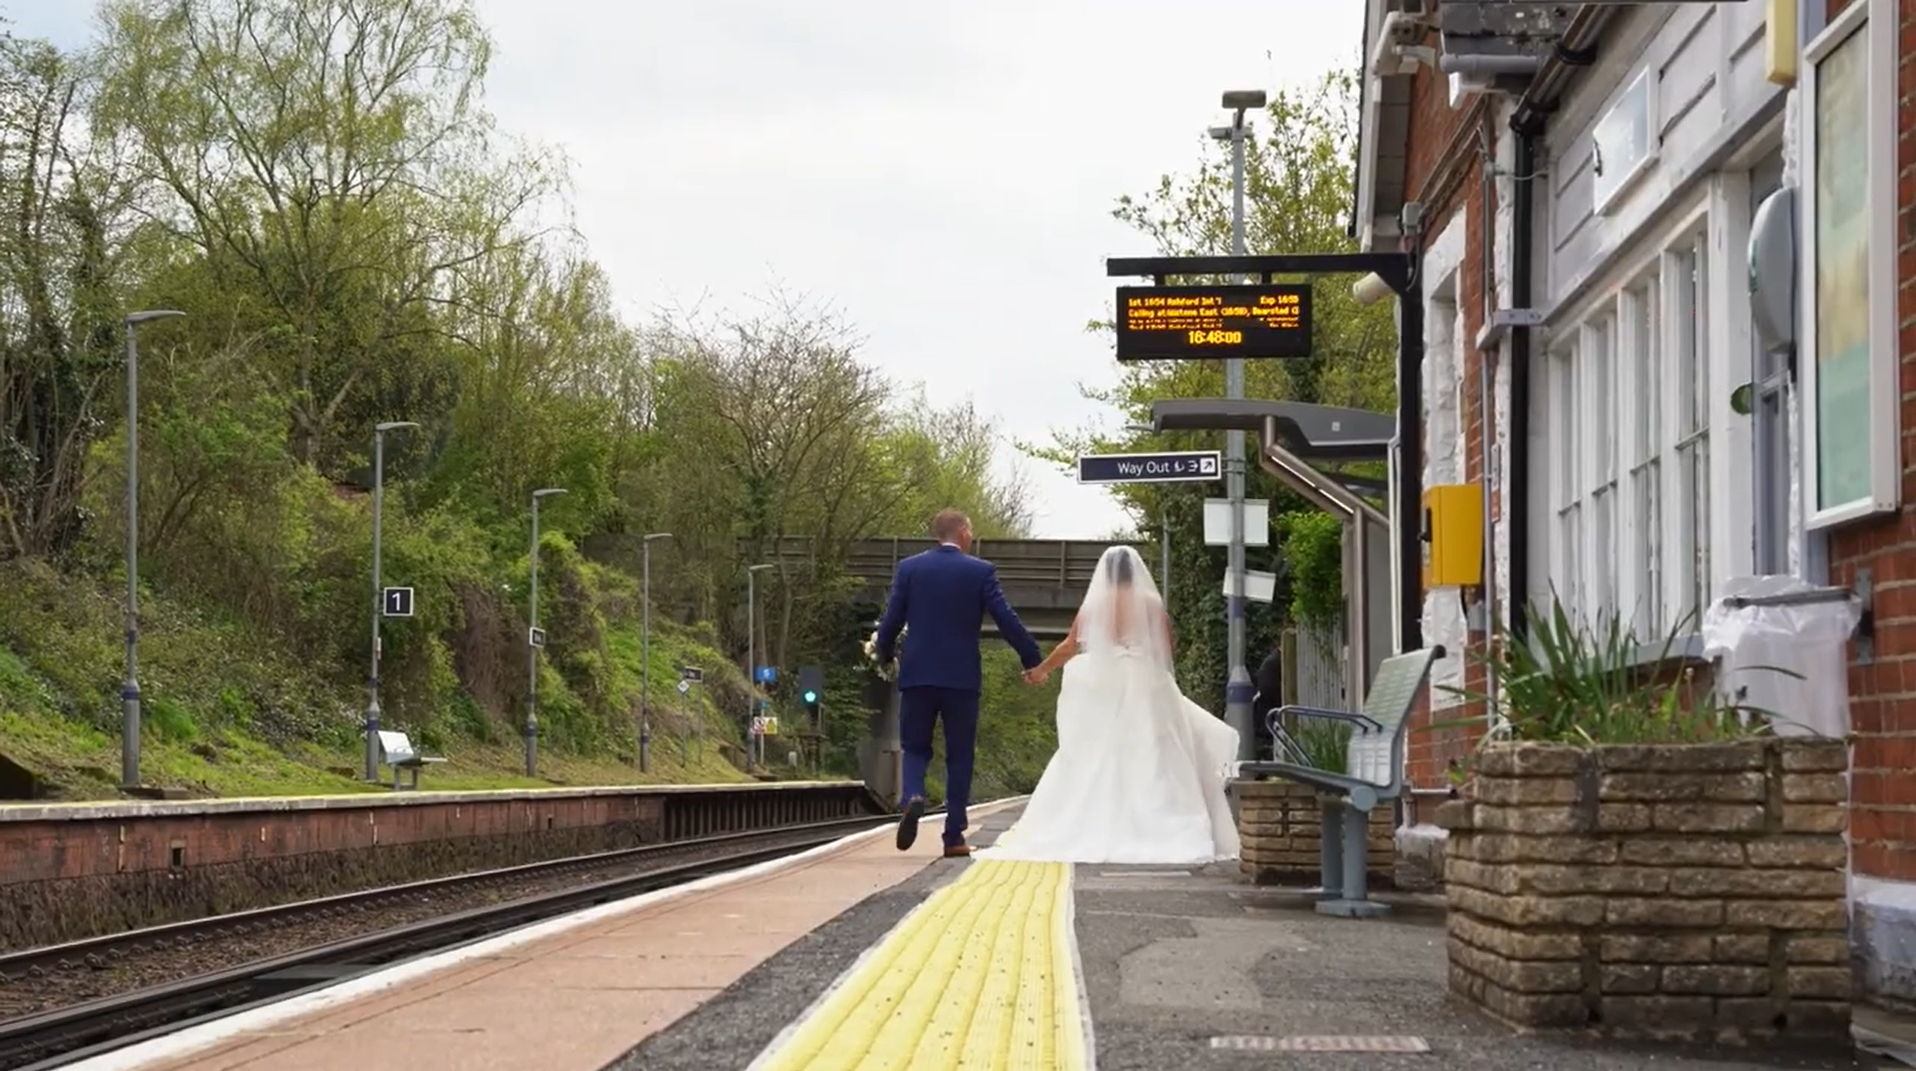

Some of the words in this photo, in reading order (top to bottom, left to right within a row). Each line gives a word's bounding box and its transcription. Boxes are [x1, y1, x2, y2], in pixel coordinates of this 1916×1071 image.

[1128, 309, 1155, 319] Calling
[1199, 307, 1218, 316] East
[1188, 330, 1242, 344] 16:48:00
[1117, 462, 1144, 476] Way
[1146, 461, 1170, 474] Out
[392, 592, 401, 611] 1
